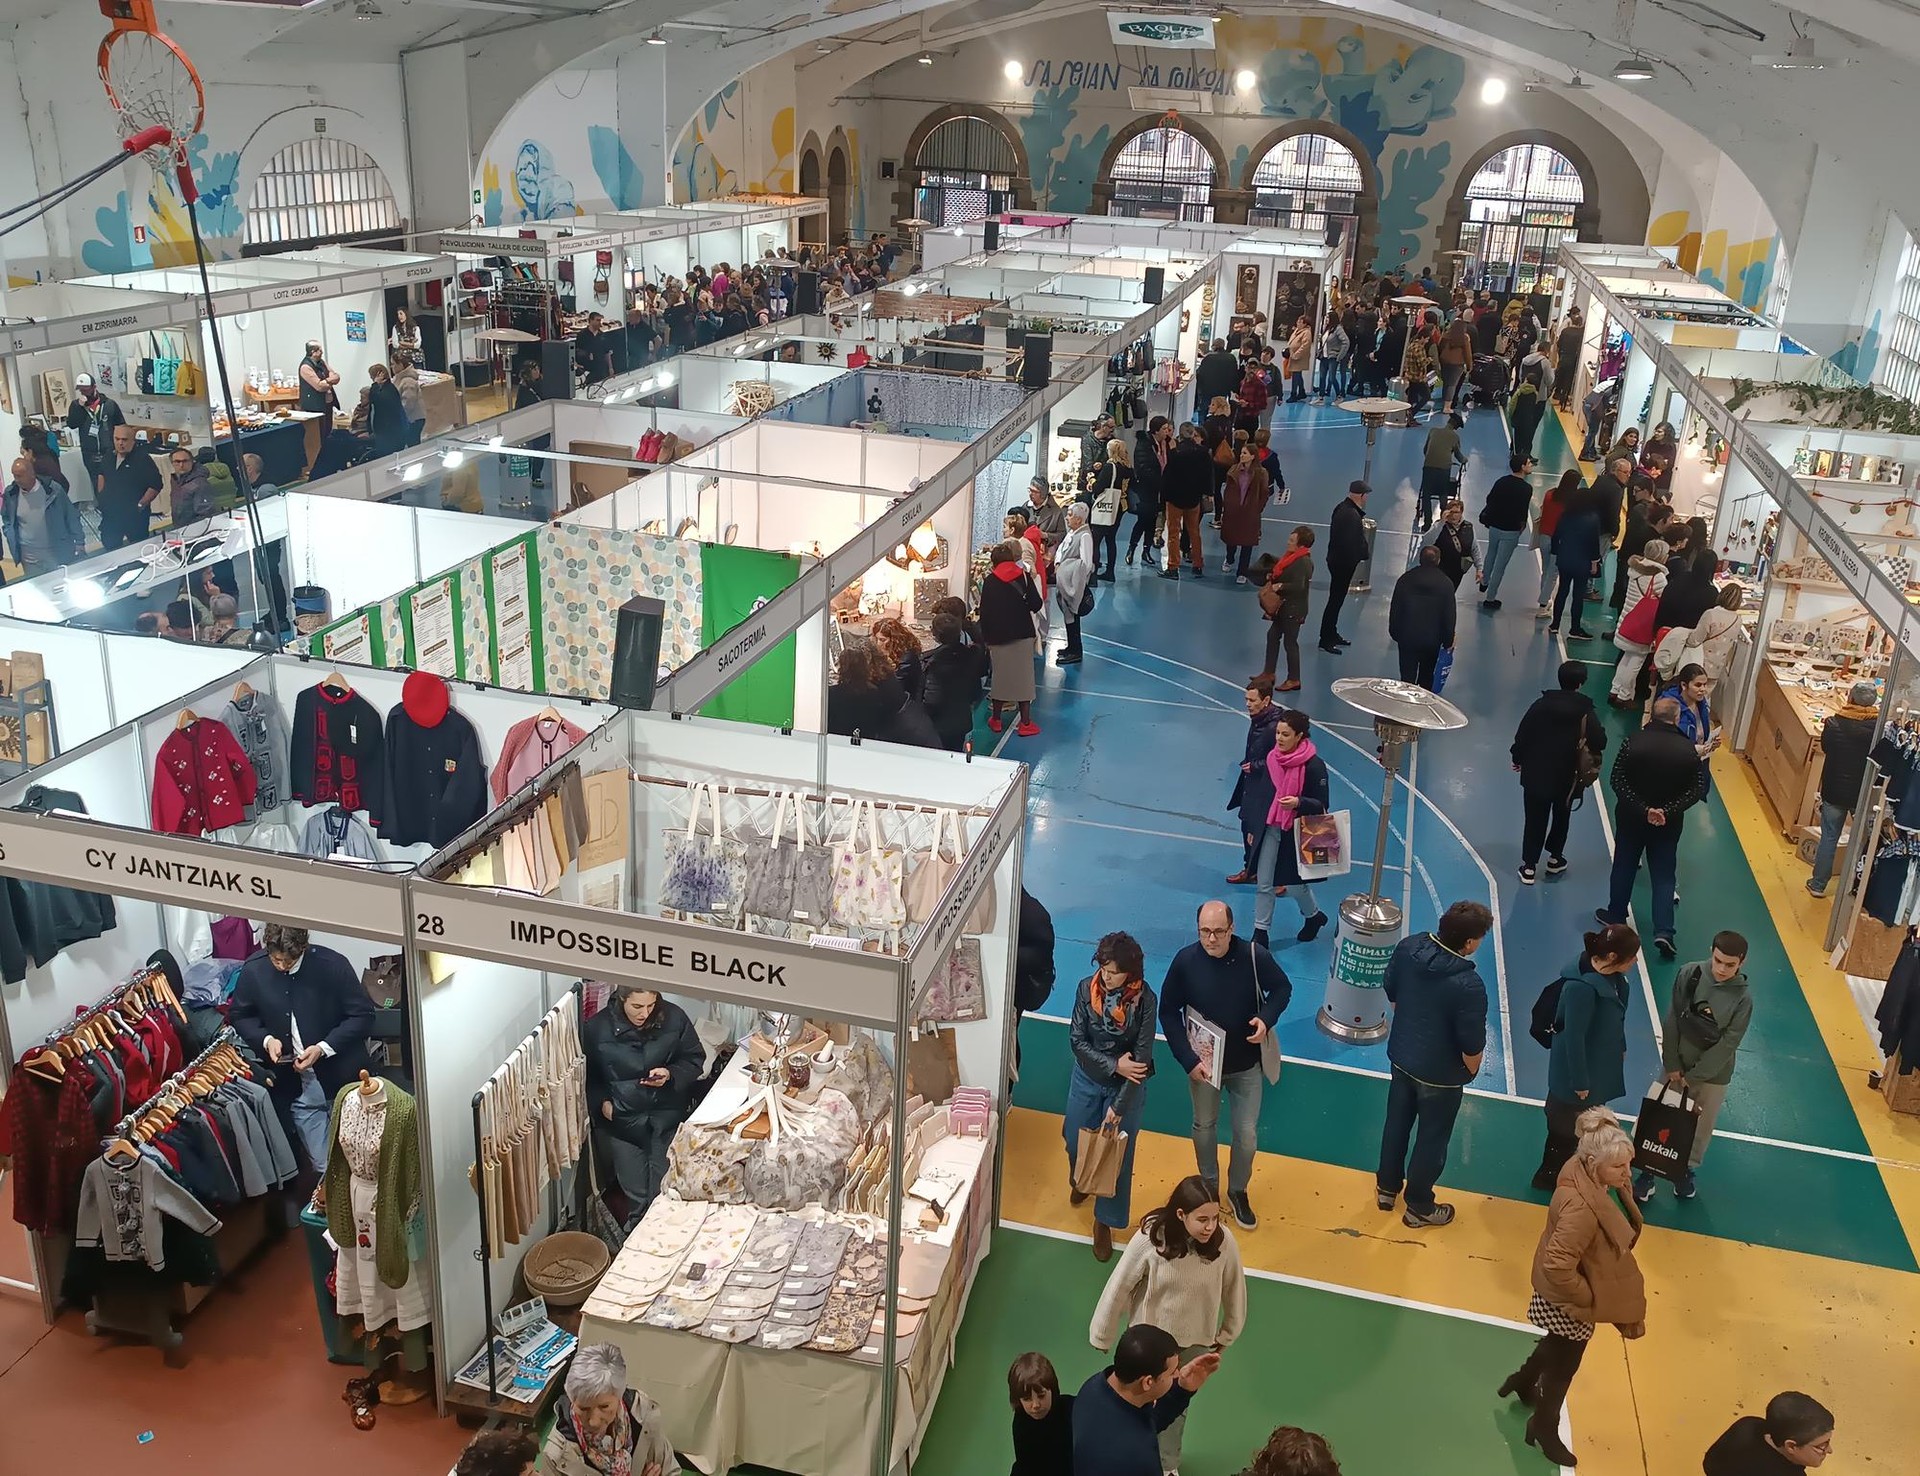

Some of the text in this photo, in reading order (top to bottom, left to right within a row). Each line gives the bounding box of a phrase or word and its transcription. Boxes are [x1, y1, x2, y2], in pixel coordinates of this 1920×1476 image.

[488, 243, 511, 251] TALLER
[513, 244, 520, 252] DE
[522, 245, 544, 253] CUERO
[94, 316, 138, 331] ZIRRIMARRA
[14, 341, 23, 350] 15
[717, 625, 767, 673] SACOTERMIA
[85, 847, 117, 870] CY
[125, 855, 244, 894] JANTZIAK
[934, 824, 1002, 951] IMPOSSIBLE BLACK
[416, 913, 445, 936] 28
[509, 919, 787, 987] IMPOSSIBLE BLACK
